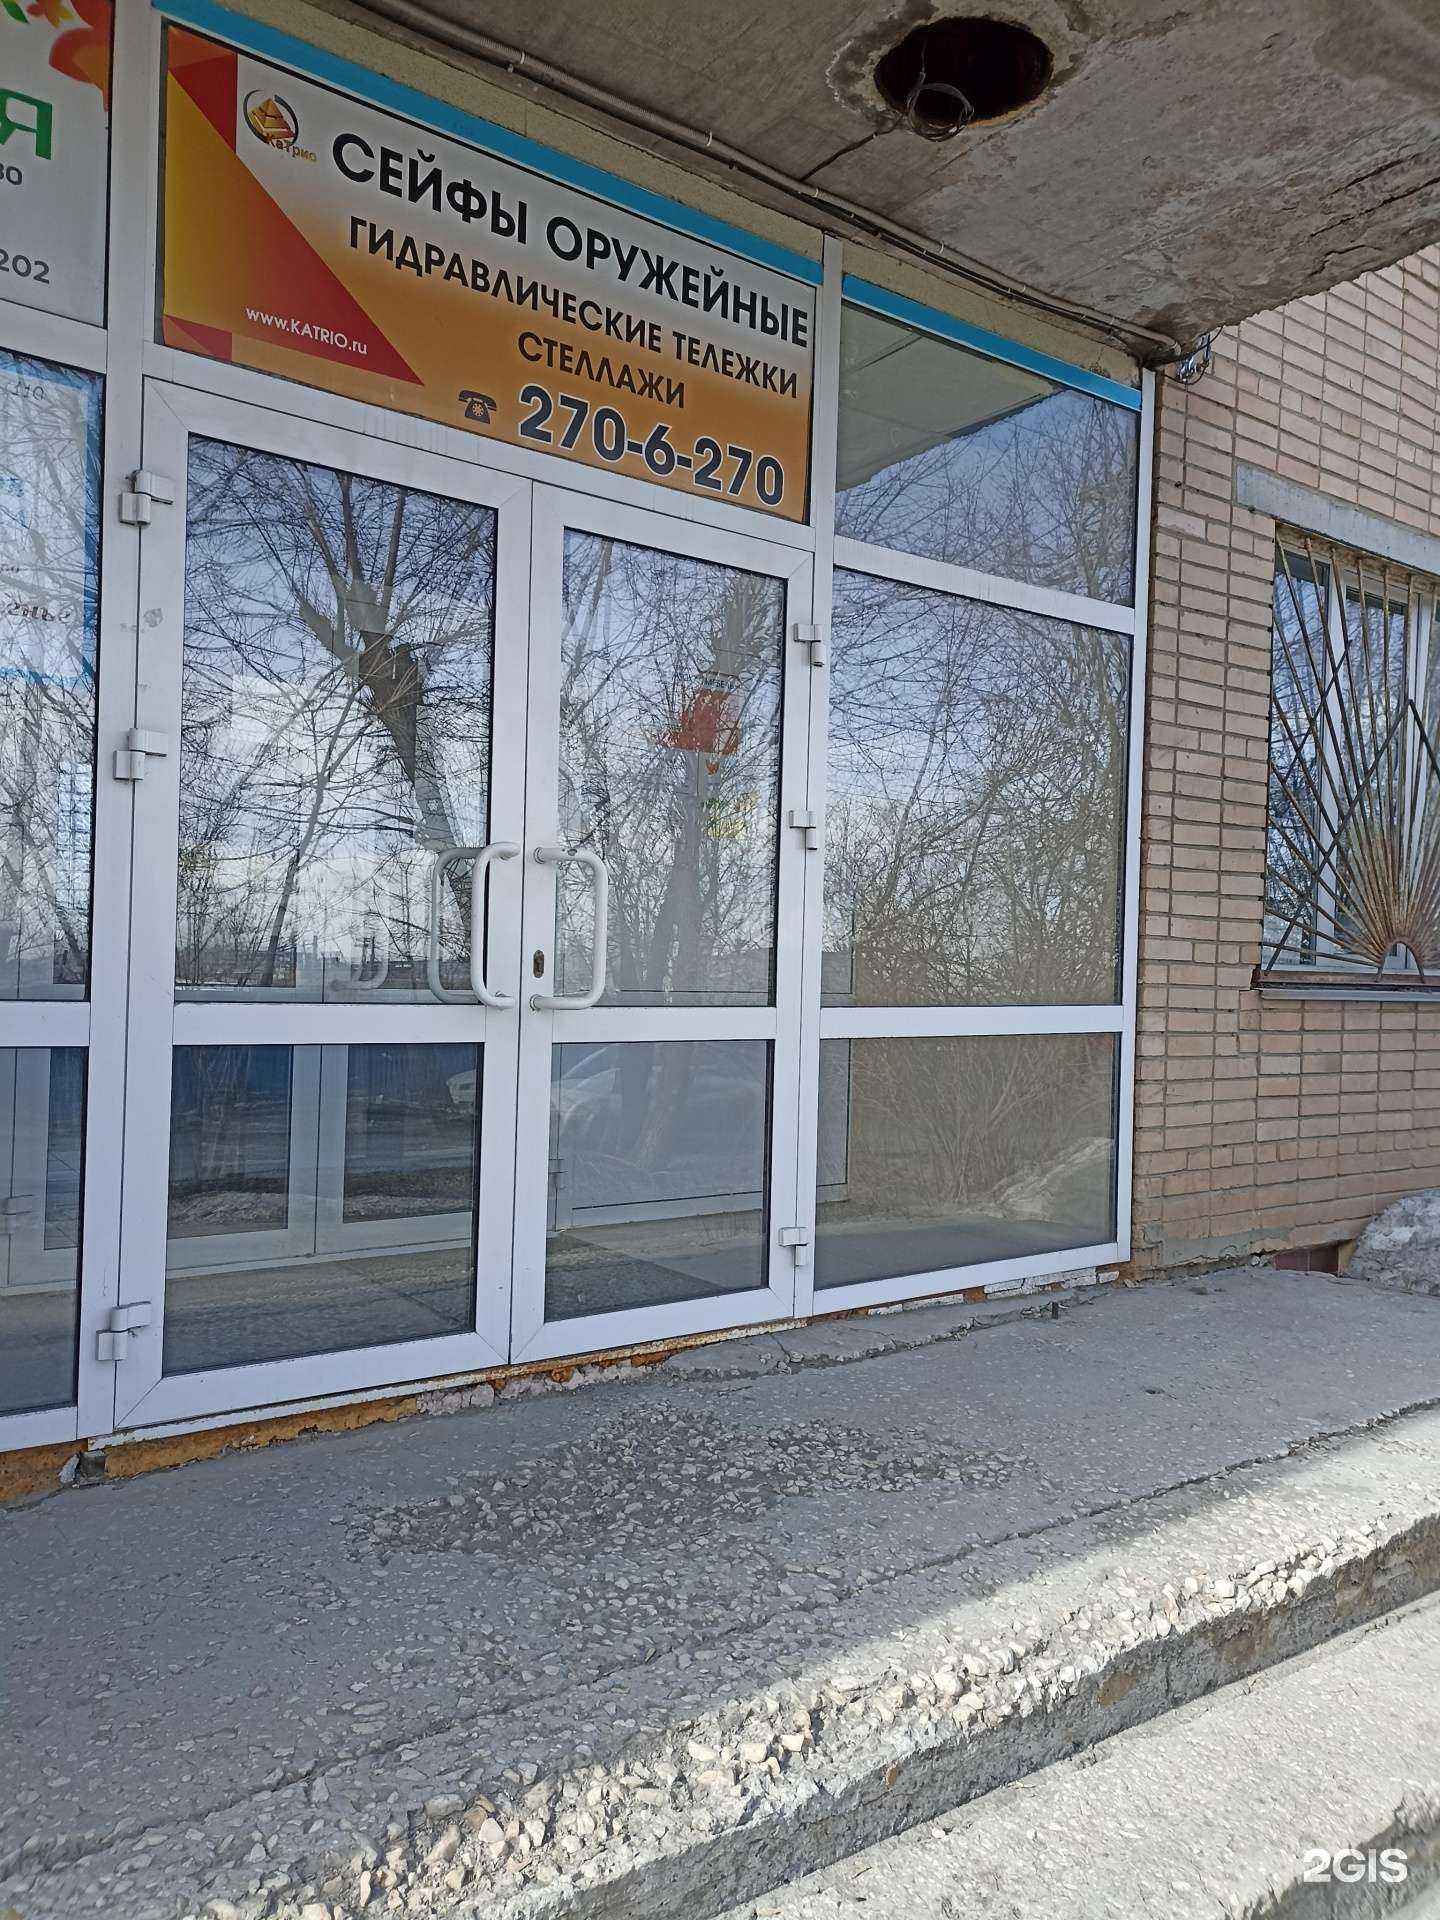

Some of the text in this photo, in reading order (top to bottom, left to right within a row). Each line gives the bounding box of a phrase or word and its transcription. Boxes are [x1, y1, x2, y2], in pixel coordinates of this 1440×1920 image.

[332, 132, 808, 348] СЕЙФЫ ОРУЖЕЙНЫЕ
[245, 307, 368, 355] www.KATRIO.ru
[350, 215, 798, 399] ГИДРАВЛИЧЕСКИЕ ТЕЛЕЖКИ
[518, 331, 685, 409] СТЕЛЛАЖИ
[518, 383, 785, 506] 270-6-270
